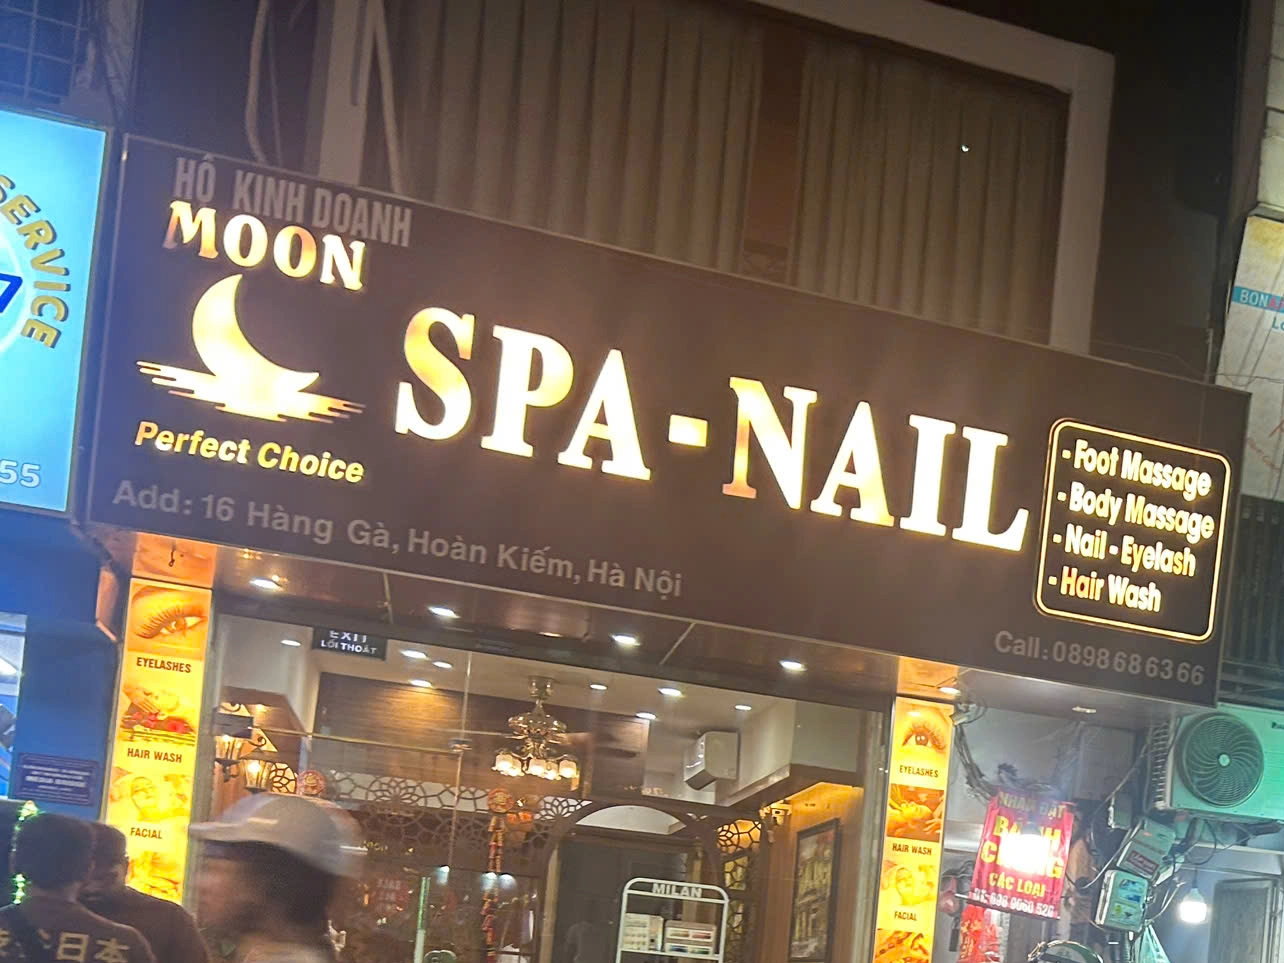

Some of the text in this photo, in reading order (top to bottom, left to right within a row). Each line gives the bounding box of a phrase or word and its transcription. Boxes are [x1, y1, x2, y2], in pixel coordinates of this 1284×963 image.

[232, 169, 308, 223] KINH
[311, 187, 412, 247] DOANH
[163, 200, 367, 291] MOON
[136, 421, 365, 484] Perfect Choice
[1073, 439, 1119, 477] Foot
[1120, 449, 1212, 501] Massage
[1069, 481, 1123, 526] Body
[1124, 493, 1215, 544] Massage
[112, 479, 682, 600] Add: 16 Hàng Gà, Hoàn Kiếm, Hà Nội
[1064, 523, 1108, 560] Nail
[1120, 535, 1196, 577] Eyelash
[1060, 565, 1104, 601] Hair
[1107, 574, 1162, 612] Wash
[136, 656, 192, 674] EYELASHES
[127, 747, 183, 764] HAIR WASH
[899, 765, 939, 778] EYELASHES
[130, 827, 163, 840] FACIAL
[892, 842, 932, 856] HAIR WASH
[651, 883, 703, 898] MILAN
[988, 872, 1046, 899] CÁC LOẠI
[894, 910, 917, 922] FACIAL
